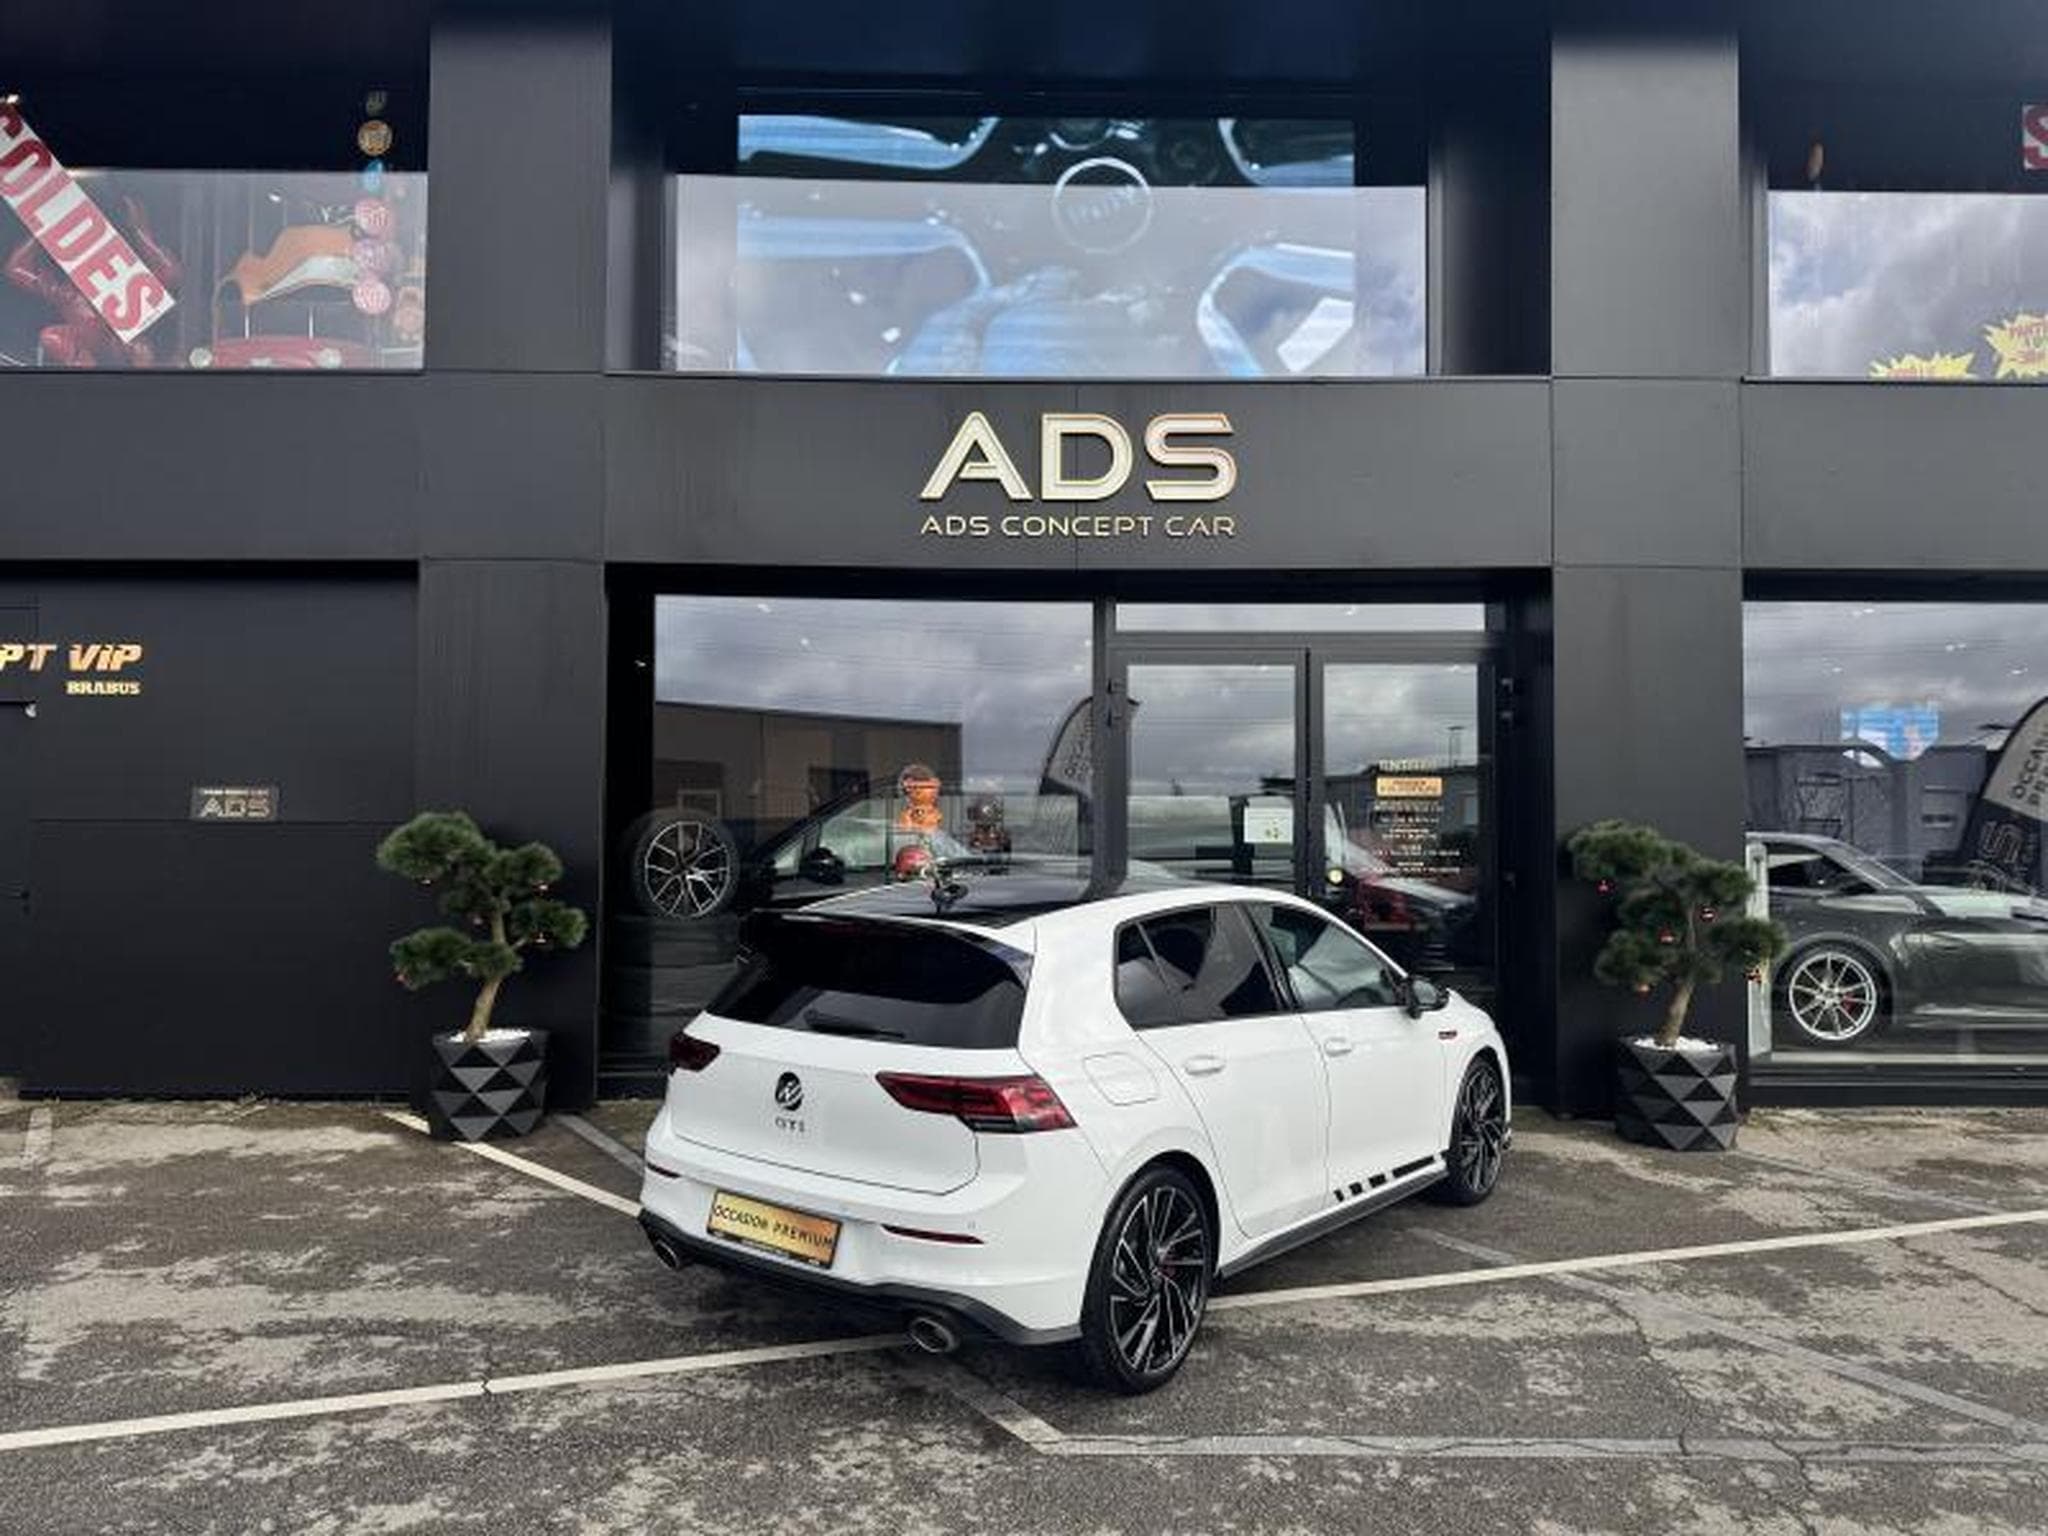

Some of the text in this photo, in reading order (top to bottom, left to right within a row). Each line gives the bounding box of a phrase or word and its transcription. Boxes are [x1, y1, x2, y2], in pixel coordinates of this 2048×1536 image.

[920, 411, 1237, 501] ADS
[920, 516, 1235, 537] ADS CONCEPT CAR
[66, 681, 140, 695] BRABUS
[200, 798, 270, 817] ADS
[773, 1222, 834, 1248] PREMIUM
